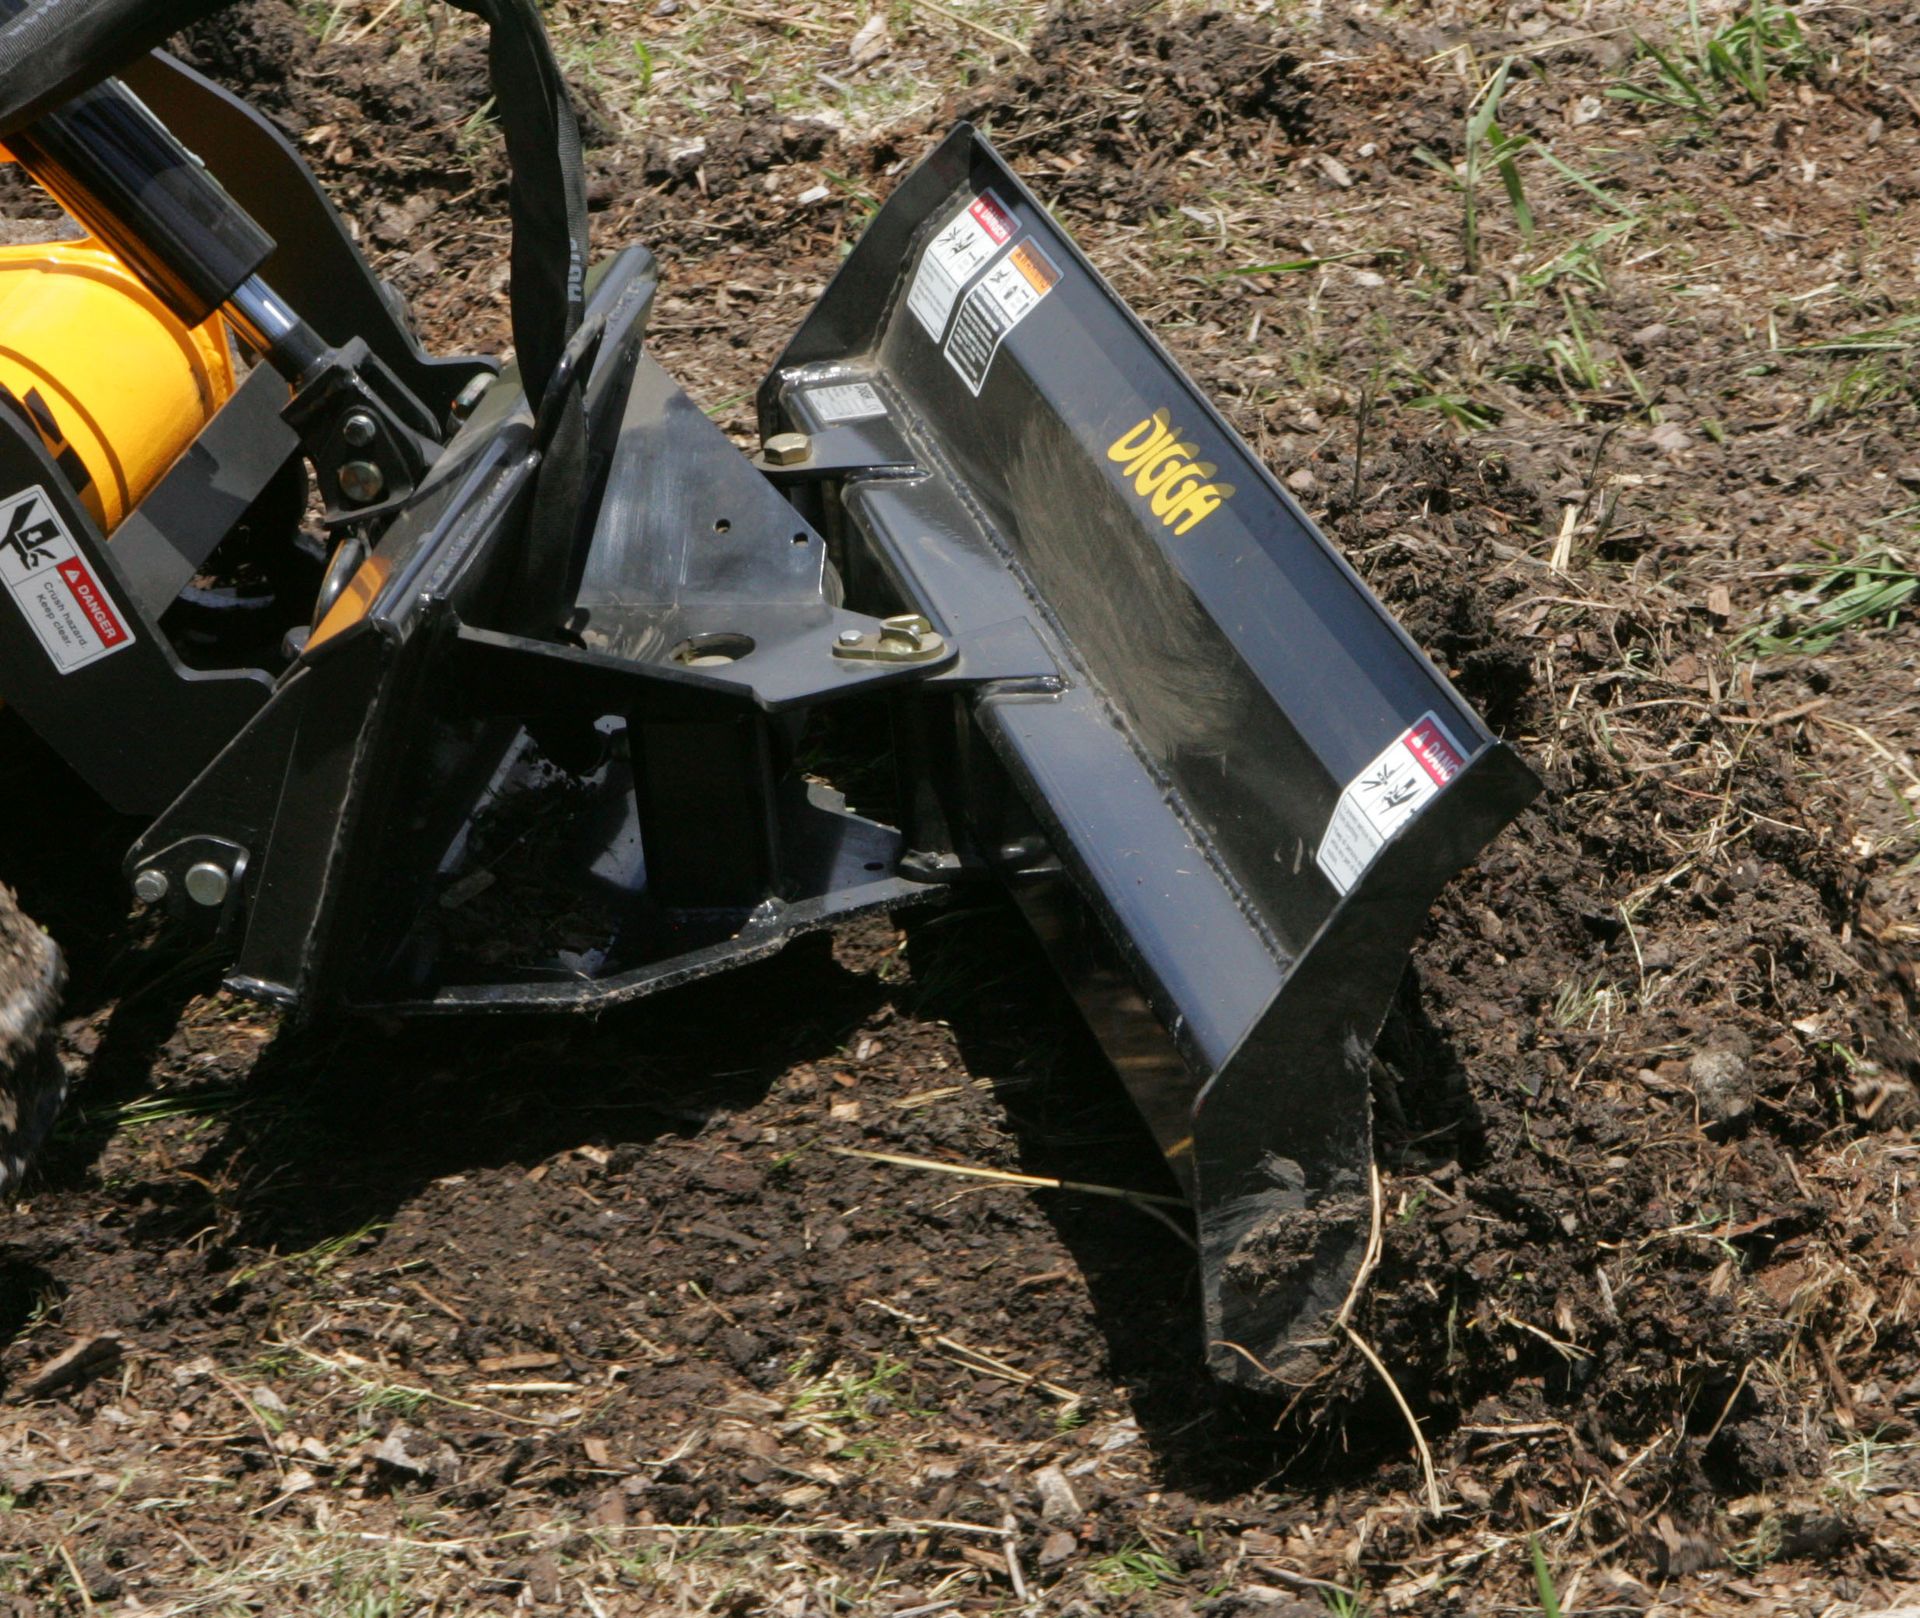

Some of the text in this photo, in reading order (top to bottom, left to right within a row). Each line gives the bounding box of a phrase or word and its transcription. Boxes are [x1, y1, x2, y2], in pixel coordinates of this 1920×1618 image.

[1107, 407, 1236, 536] DIGGA
[36, 593, 55, 619] Keep
[52, 620, 73, 647] clear.
[44, 581, 88, 649] Crush hazard.
[77, 584, 117, 639] DANGER
[1422, 742, 1459, 782] DANG
